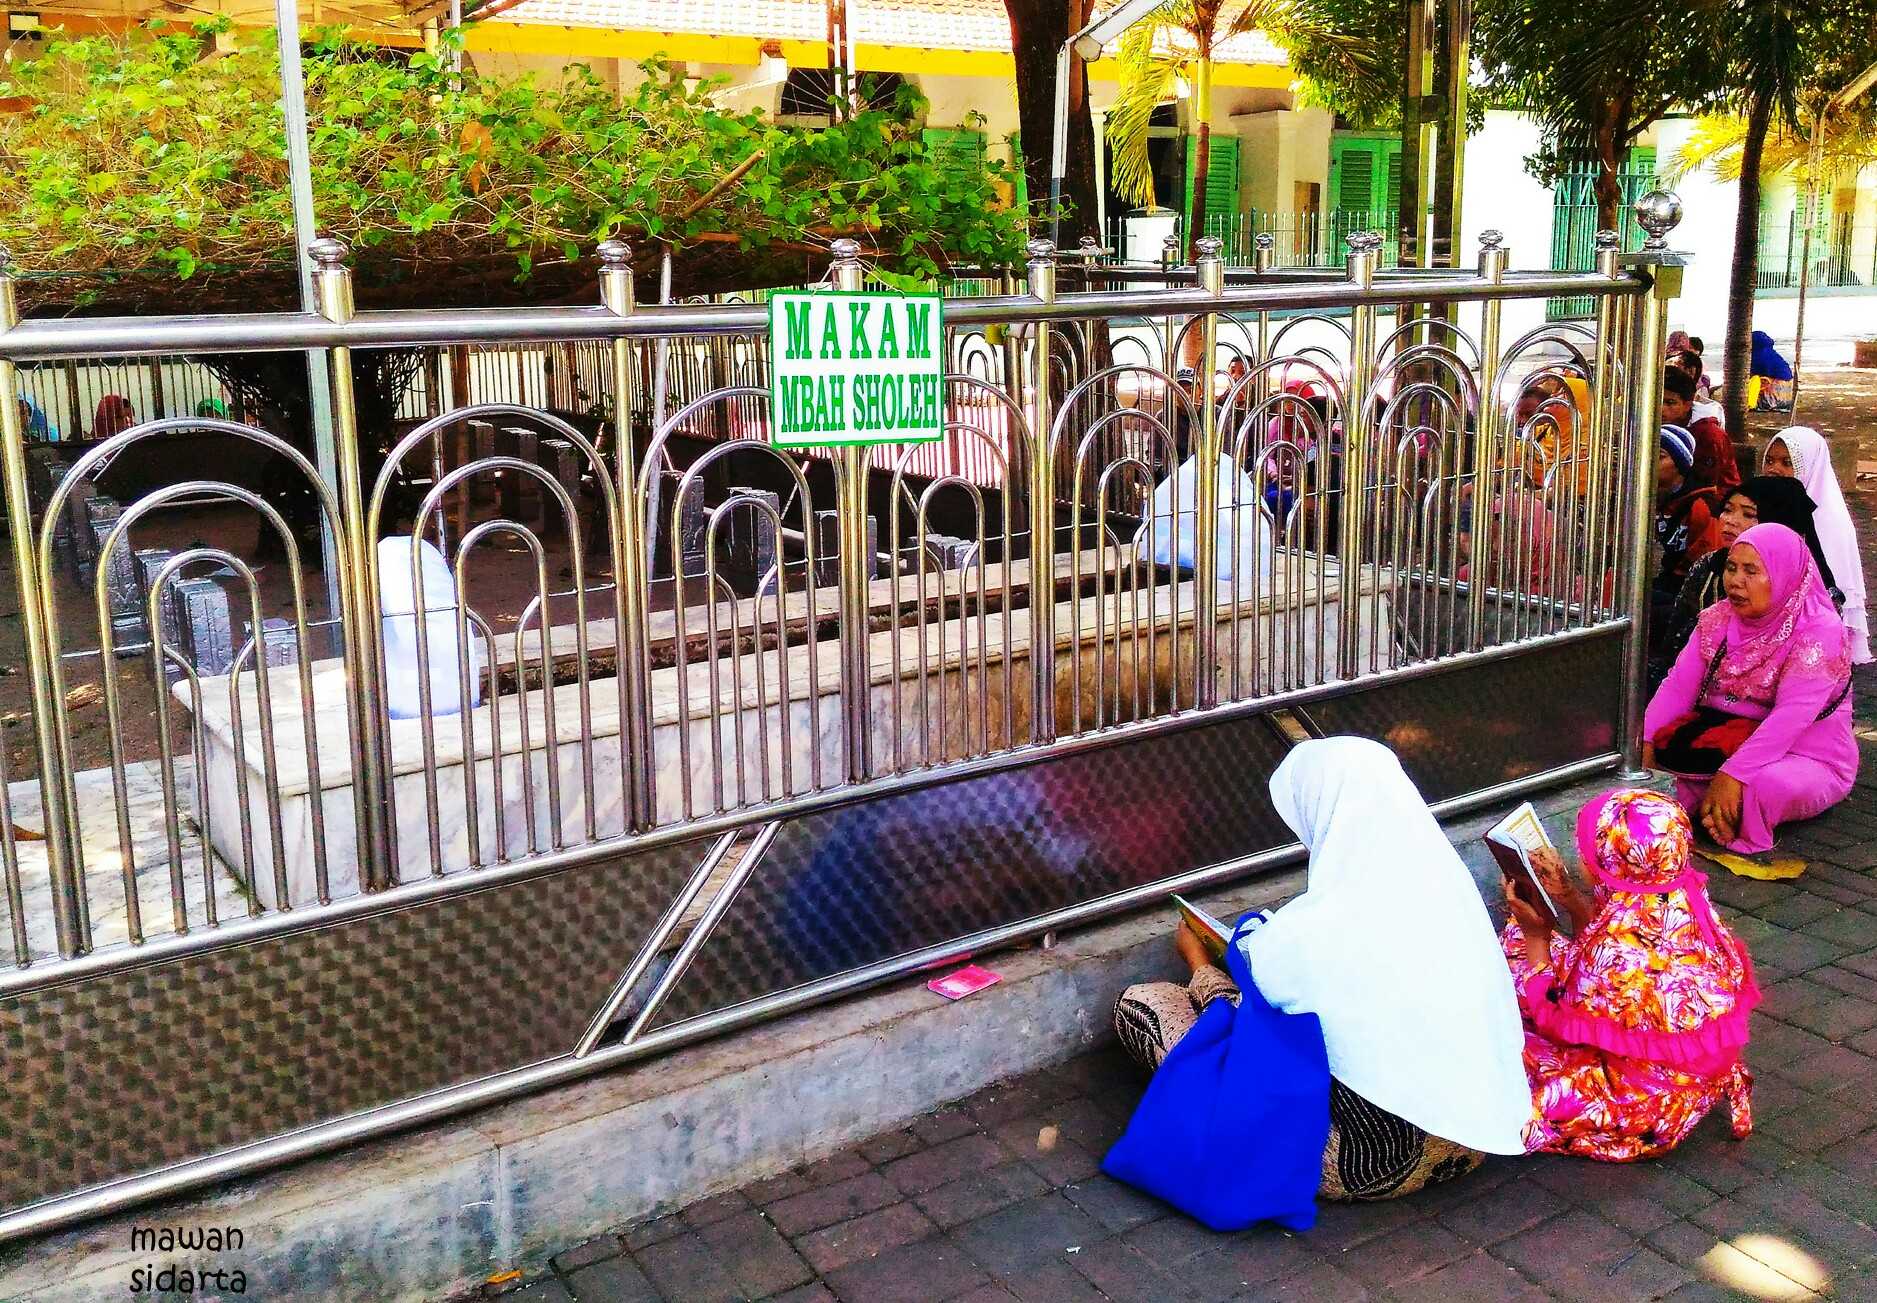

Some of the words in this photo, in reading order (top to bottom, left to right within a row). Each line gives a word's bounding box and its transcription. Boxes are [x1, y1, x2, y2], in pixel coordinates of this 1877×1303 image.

[784, 301, 931, 359] MAKAM
[780, 375, 845, 433] MBAH
[853, 373, 938, 431] SHOLEH
